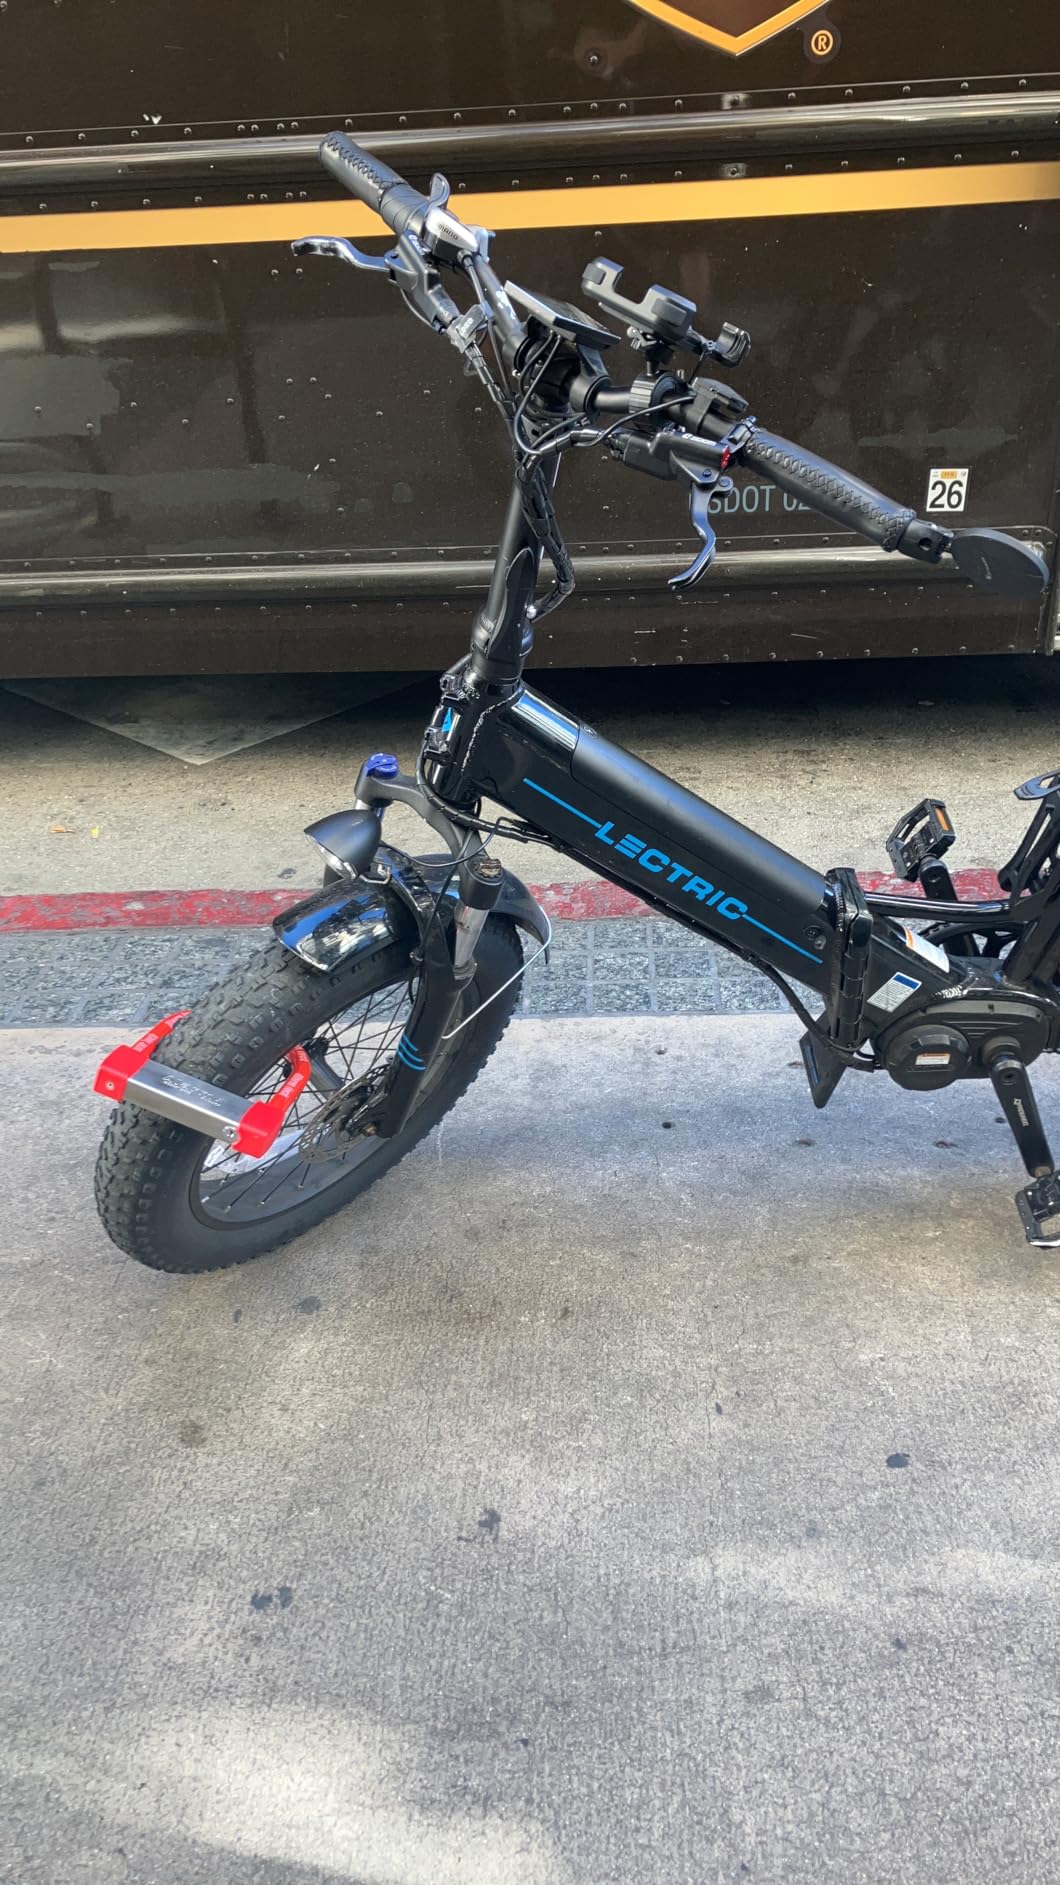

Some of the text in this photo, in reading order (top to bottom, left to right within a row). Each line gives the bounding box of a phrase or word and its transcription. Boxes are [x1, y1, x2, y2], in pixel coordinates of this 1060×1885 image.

[689, 485, 776, 514] SDOT
[928, 480, 964, 509] 26
[594, 820, 748, 920] LECTRIC
